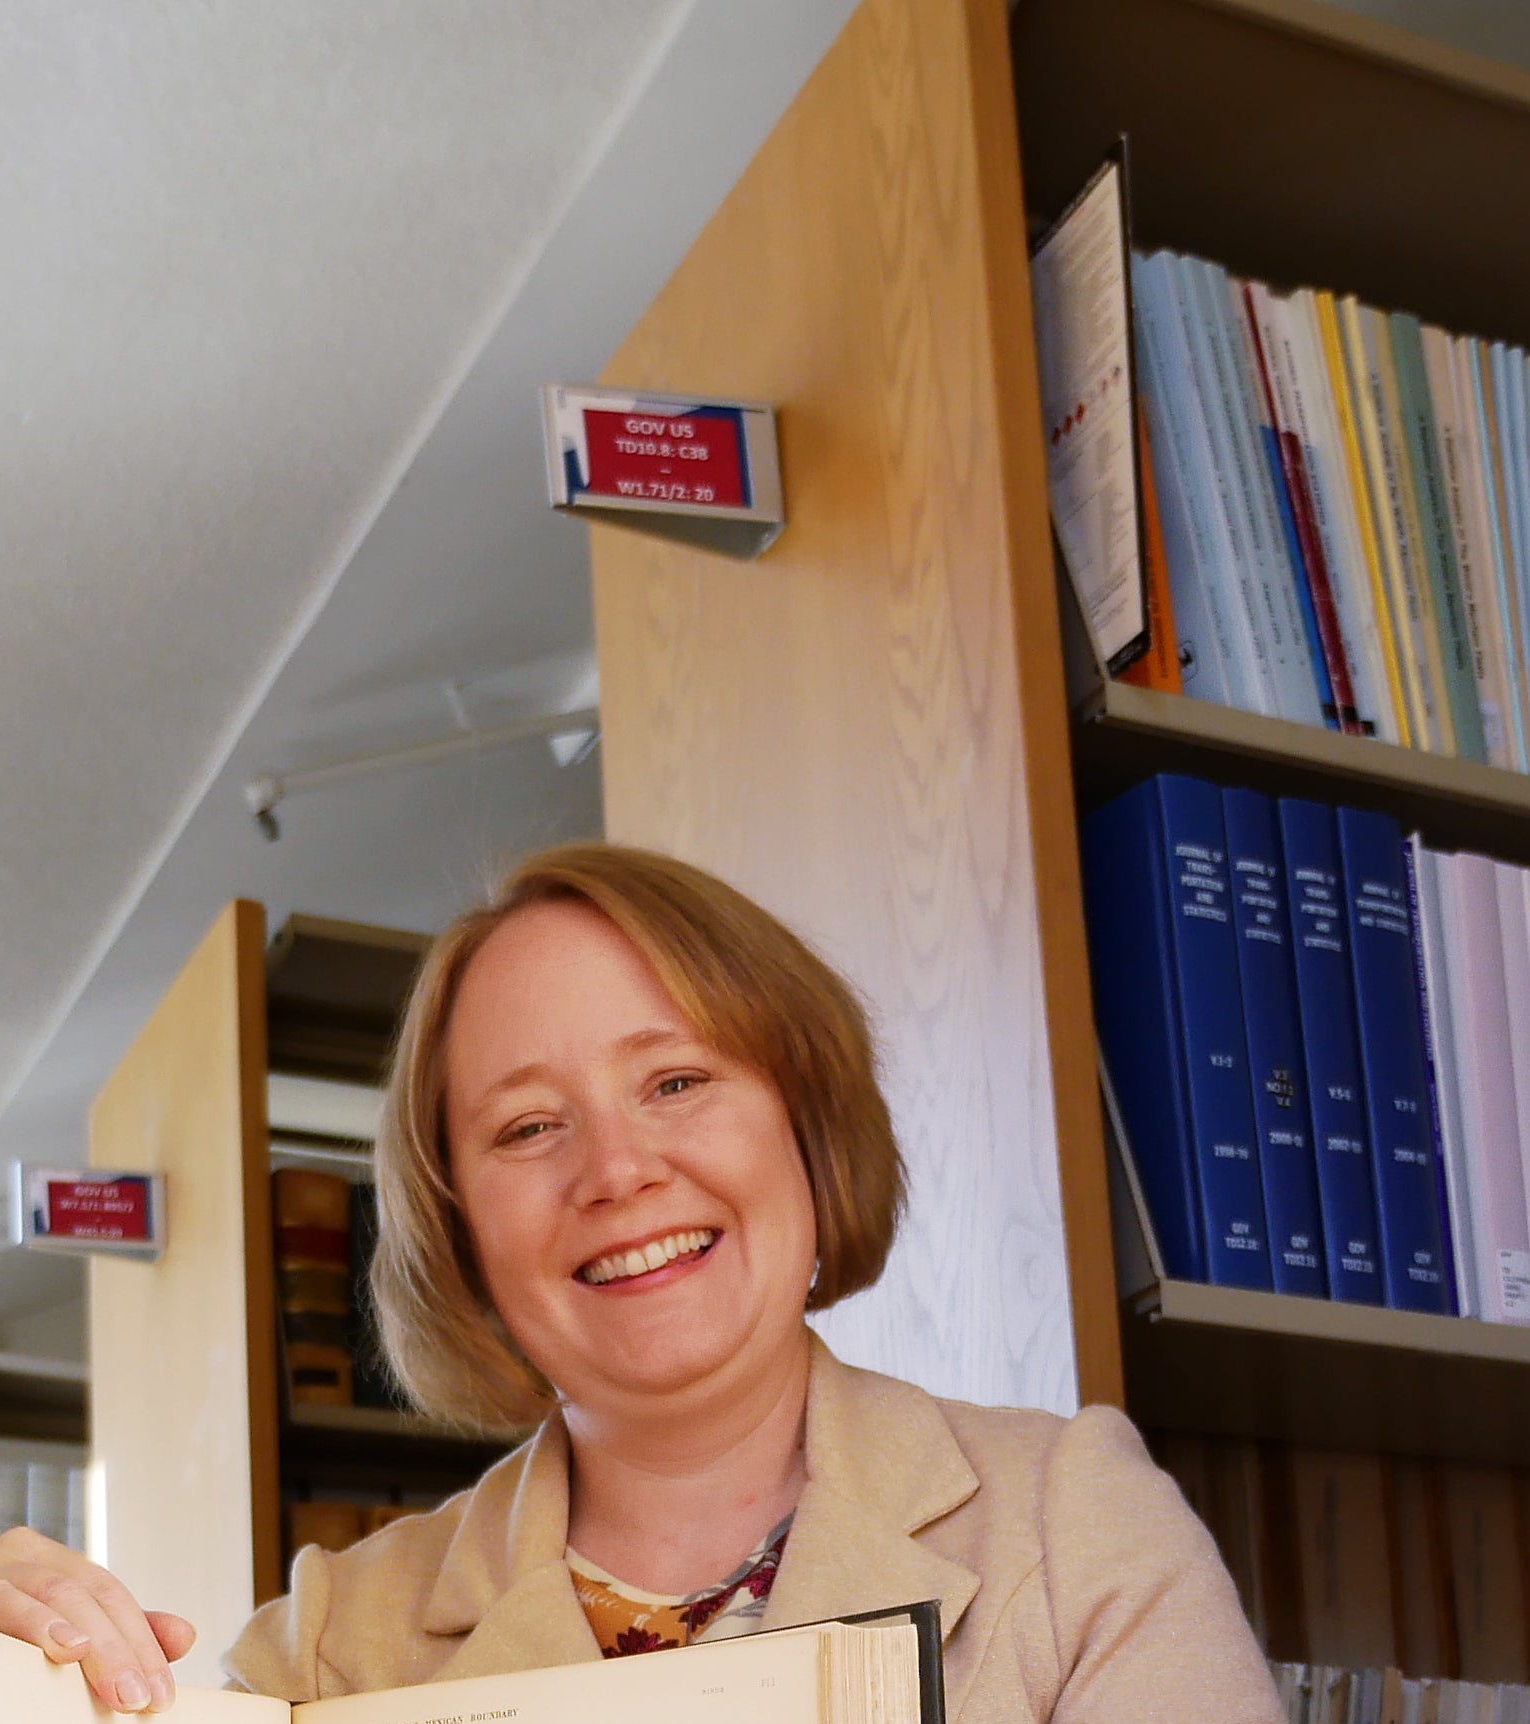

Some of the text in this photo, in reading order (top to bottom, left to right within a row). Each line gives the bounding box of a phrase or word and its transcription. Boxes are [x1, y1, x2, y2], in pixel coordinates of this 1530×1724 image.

[625, 418, 694, 438] GOV US
[694, 487, 714, 502] 20
[470, 1708, 519, 1722] BOUNDARY
